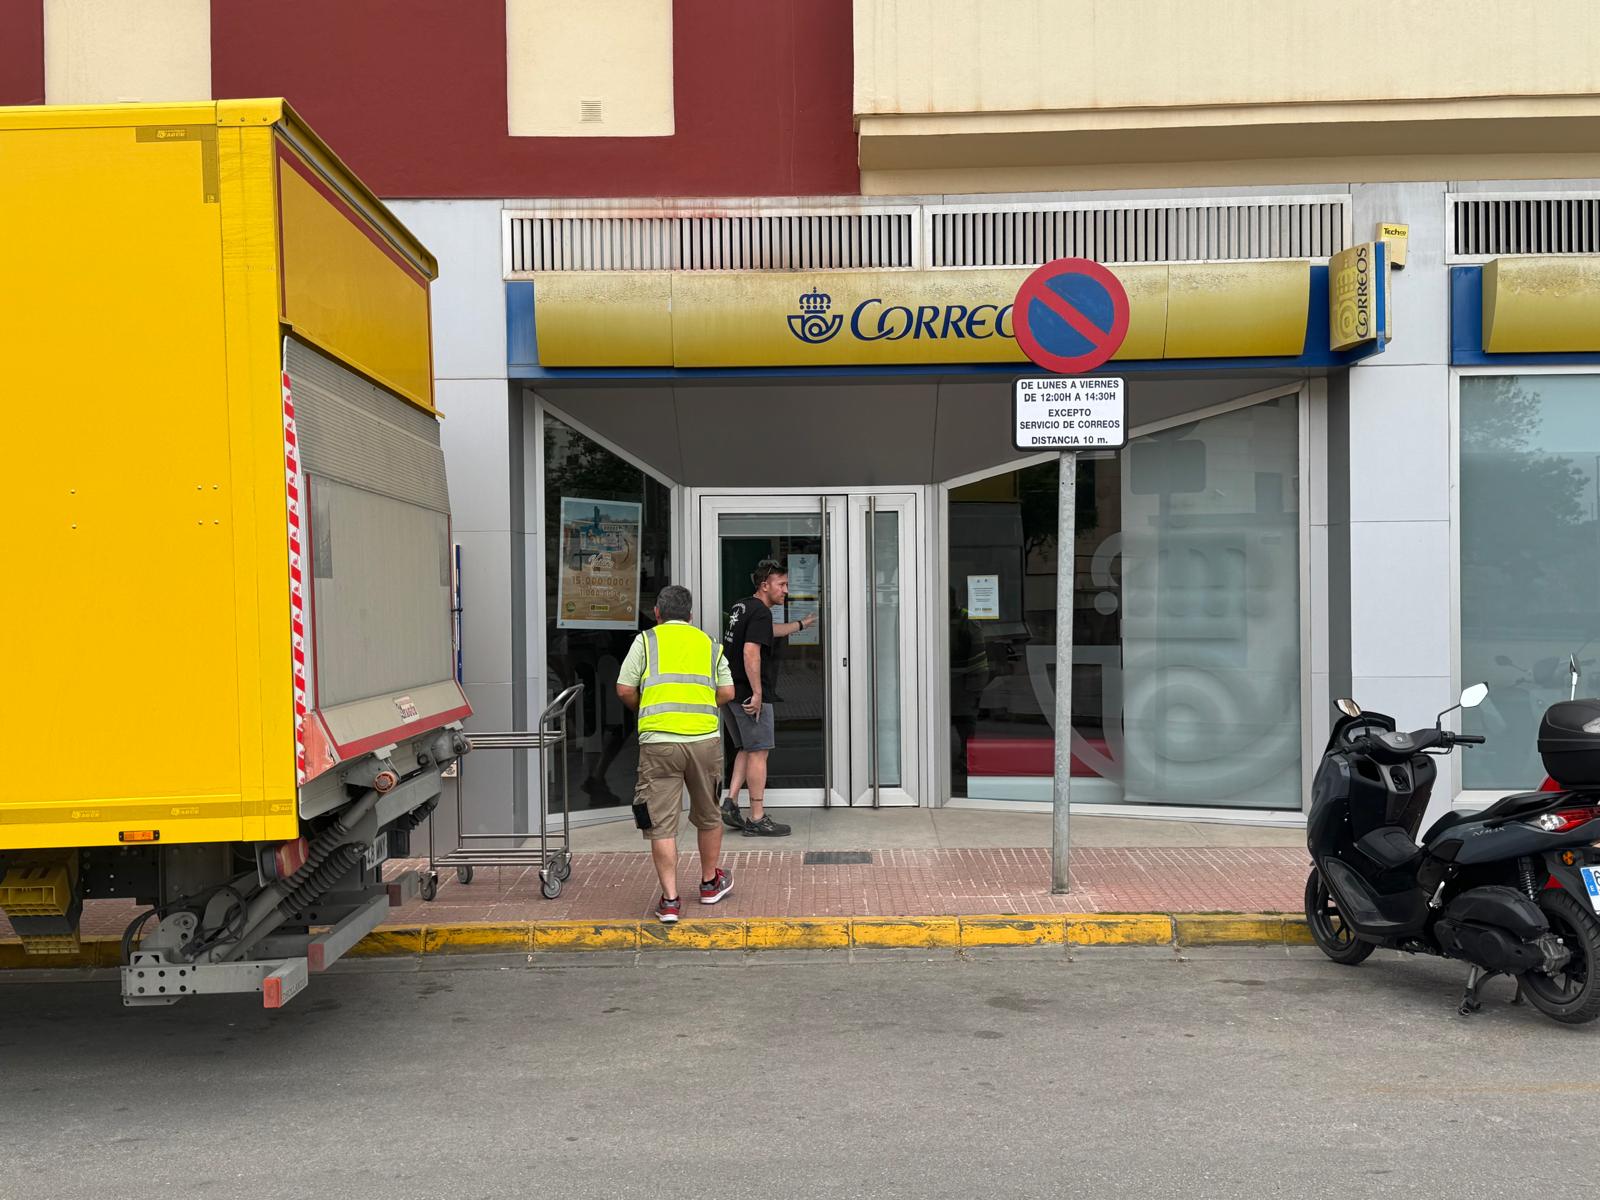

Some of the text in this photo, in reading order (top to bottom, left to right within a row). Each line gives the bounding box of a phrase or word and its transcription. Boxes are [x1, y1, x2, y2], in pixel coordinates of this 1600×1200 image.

[1355, 247, 1369, 338] CORREOS
[850, 298, 1015, 341] CORREO
[1021, 379, 1119, 390] DE LUNES A VIERNES
[1024, 392, 1116, 402] DE 12:00H A 14:30H
[1048, 408, 1092, 417] EXCEPTO
[1020, 420, 1120, 430] SERVICIO DE CORREOS
[1031, 436, 1108, 445] DISTANCIA 10 m.
